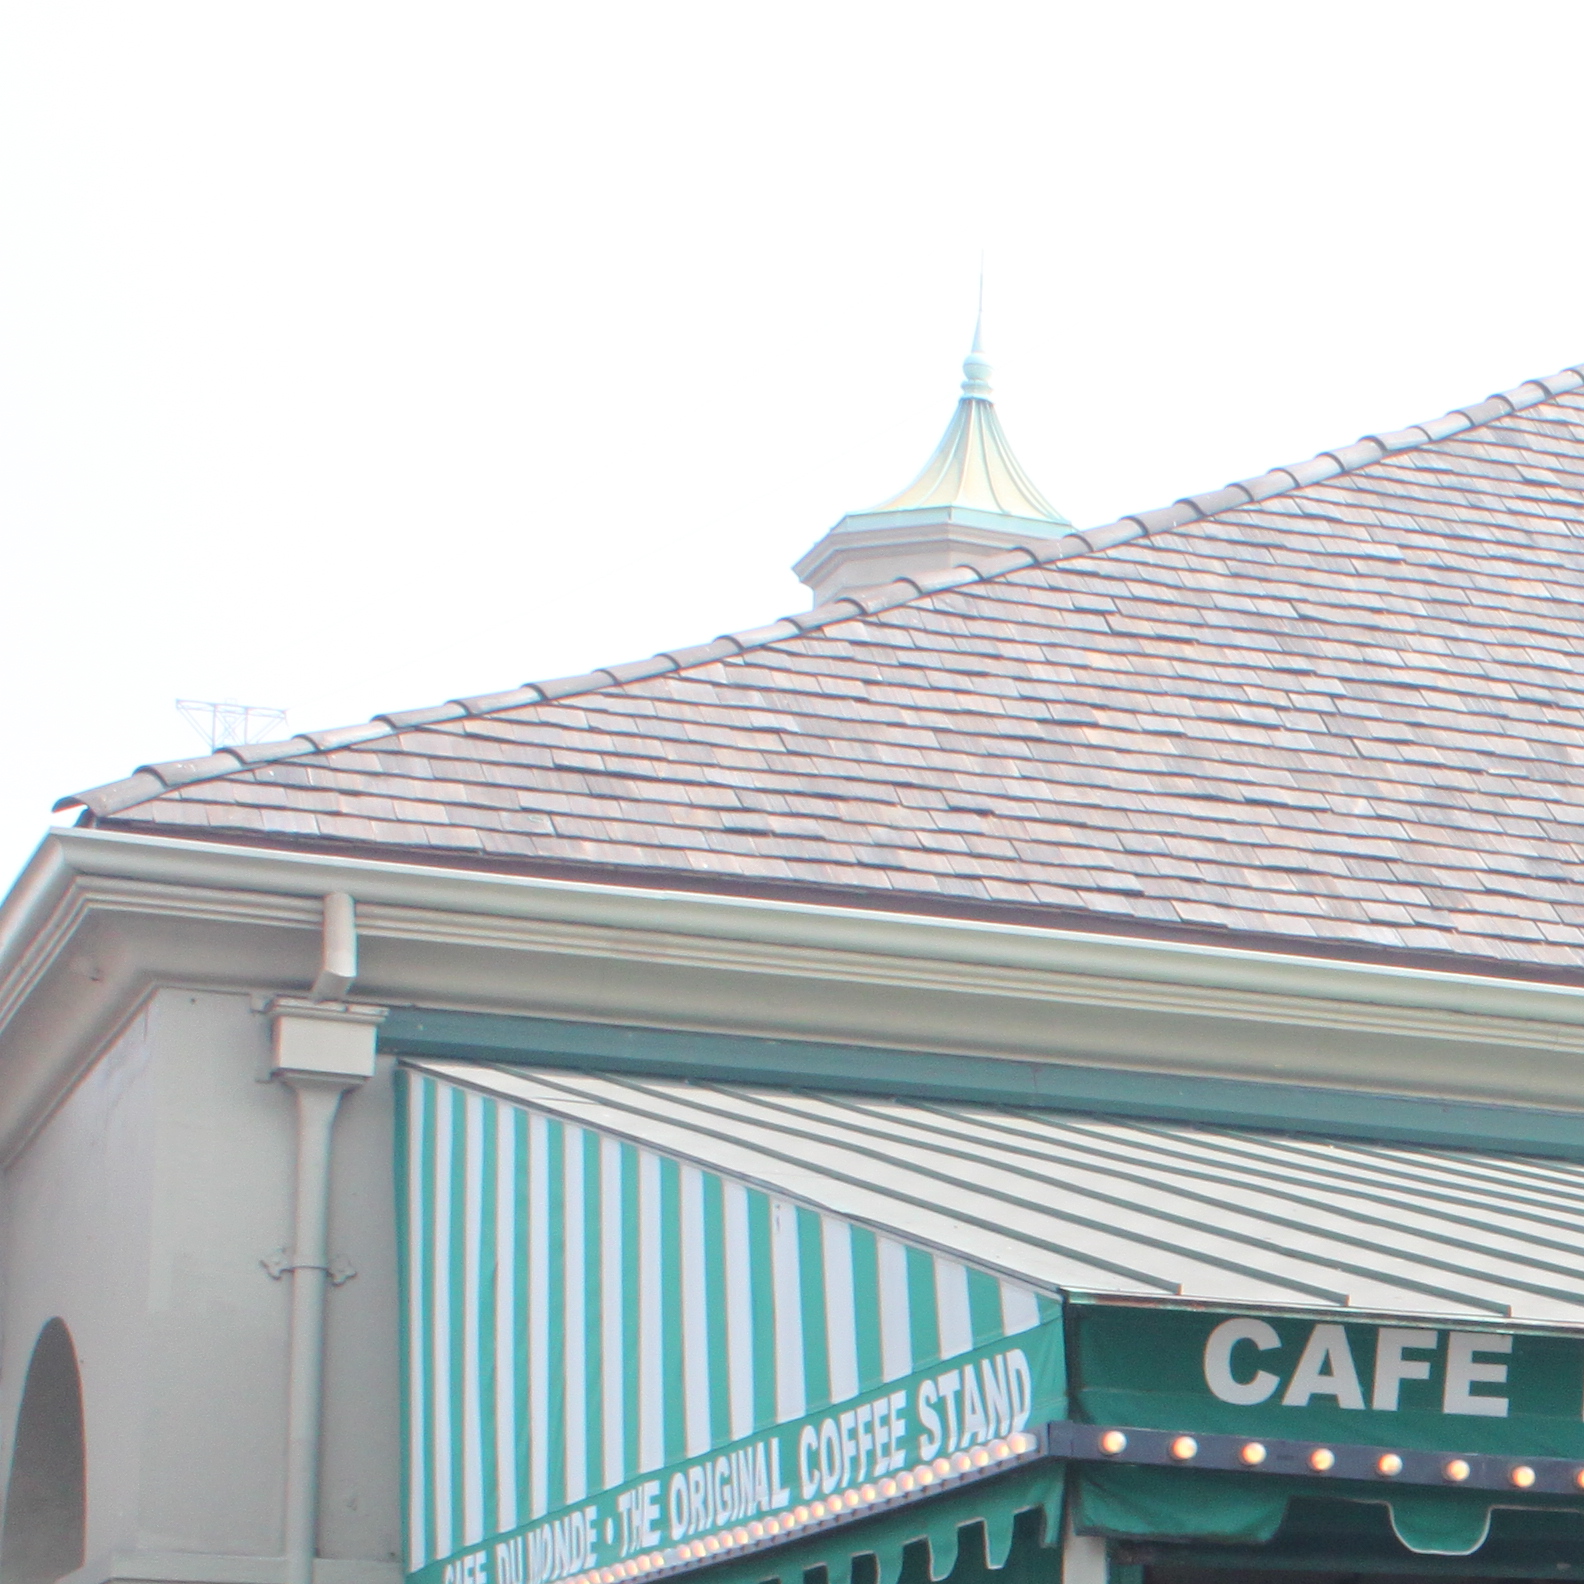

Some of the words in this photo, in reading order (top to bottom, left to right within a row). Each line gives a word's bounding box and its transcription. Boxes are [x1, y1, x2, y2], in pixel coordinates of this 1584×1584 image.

[1202, 1316, 1512, 1418] CAFE
[617, 1479, 662, 1557] THE
[669, 1436, 790, 1540] ORIGINAL
[798, 1389, 907, 1500] COFFEE
[917, 1348, 1032, 1461] STAND
